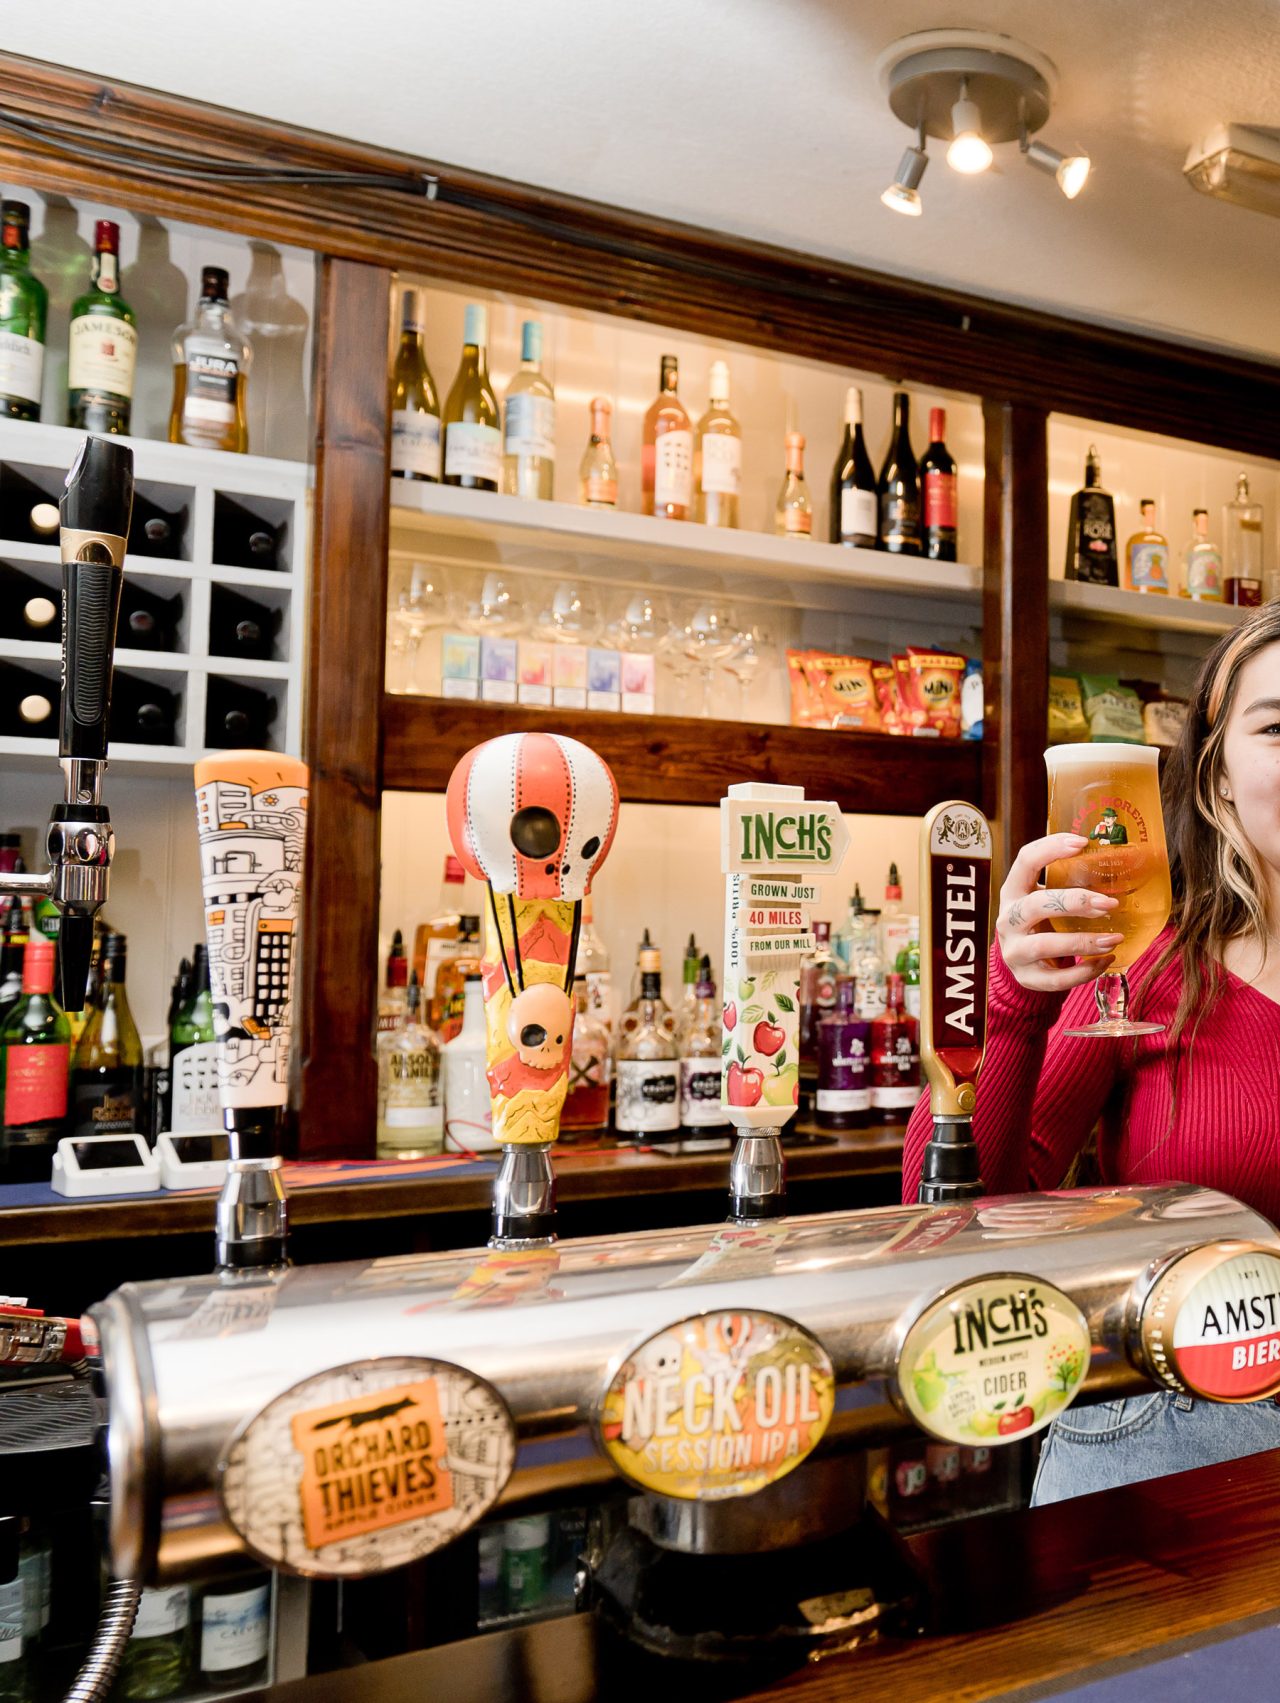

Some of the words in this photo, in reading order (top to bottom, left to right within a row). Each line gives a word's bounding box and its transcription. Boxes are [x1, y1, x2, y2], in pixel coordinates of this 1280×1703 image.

[74, 317, 137, 346] JAMESON
[189, 355, 237, 374] JURA
[740, 811, 833, 862] INCH'S
[1101, 796, 1149, 843] MORETTI
[751, 883, 789, 898] GROWN
[791, 887, 816, 900] JUST
[749, 910, 765, 926] 40
[768, 911, 803, 926] MILES
[750, 940, 773, 952] FROM
[775, 939, 791, 950] OUR
[793, 938, 812, 949] MILL
[945, 864, 976, 1036] AMSTEL
[953, 1288, 1049, 1356] INCH'S
[1232, 1338, 1280, 1371] BIER
[621, 1369, 744, 1441] NECK
[755, 1363, 820, 1429] OIL
[984, 1371, 1027, 1396] CIDER
[313, 1420, 432, 1478] ORCHARD
[644, 1434, 753, 1474] SESSION
[760, 1428, 799, 1464] IPA
[319, 1455, 437, 1518] THIEVES
